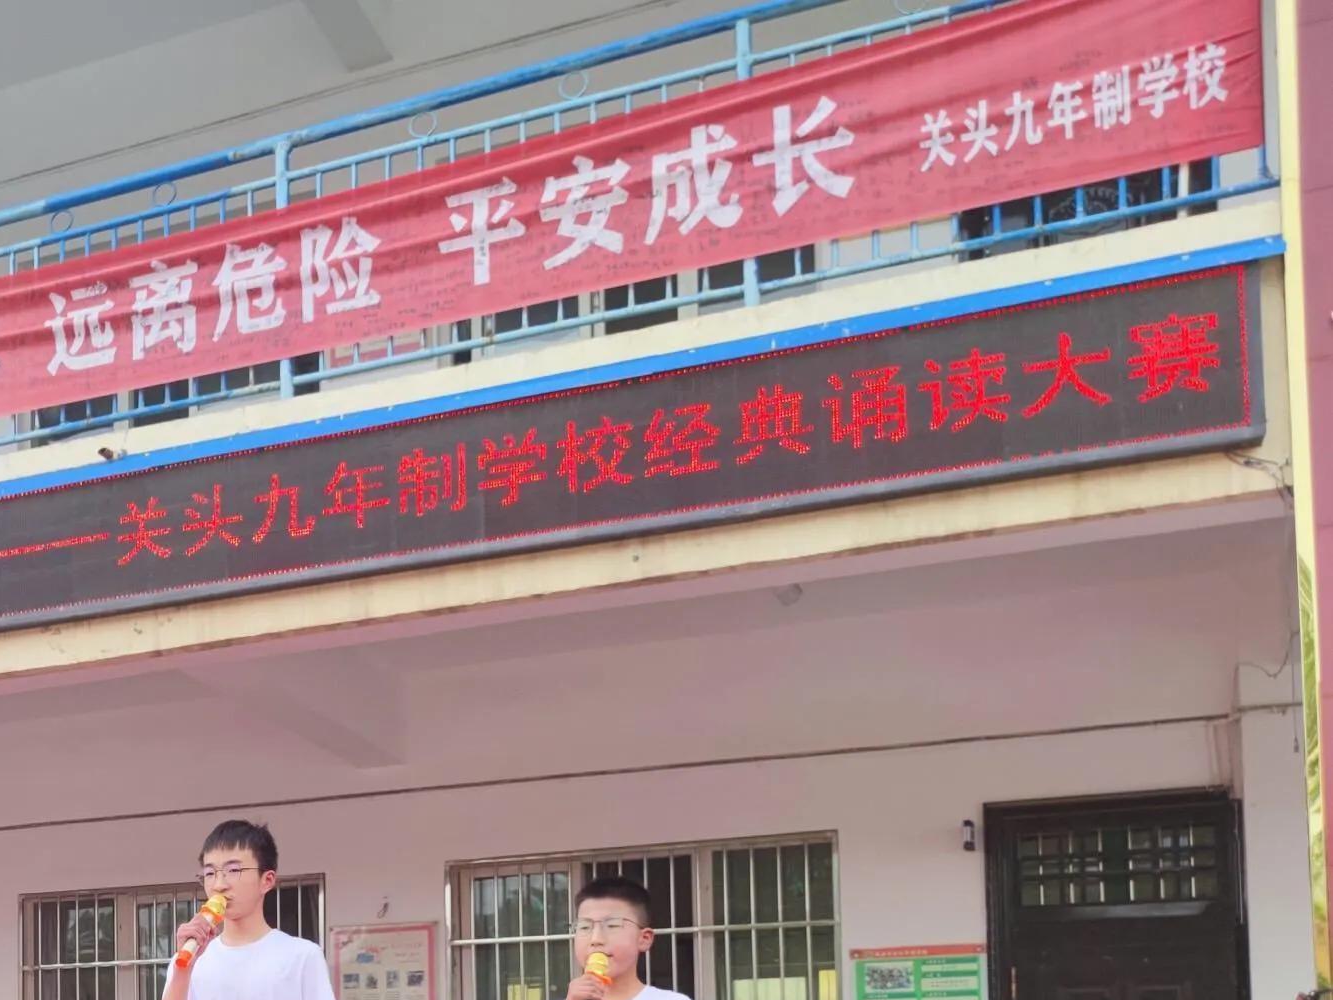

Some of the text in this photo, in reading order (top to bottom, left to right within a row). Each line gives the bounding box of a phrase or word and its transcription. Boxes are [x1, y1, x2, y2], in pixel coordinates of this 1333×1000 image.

[45, 217, 382, 376] 远离危险
[438, 97, 855, 286] 平安成长
[919, 43, 1229, 172] 关头九年制学校
